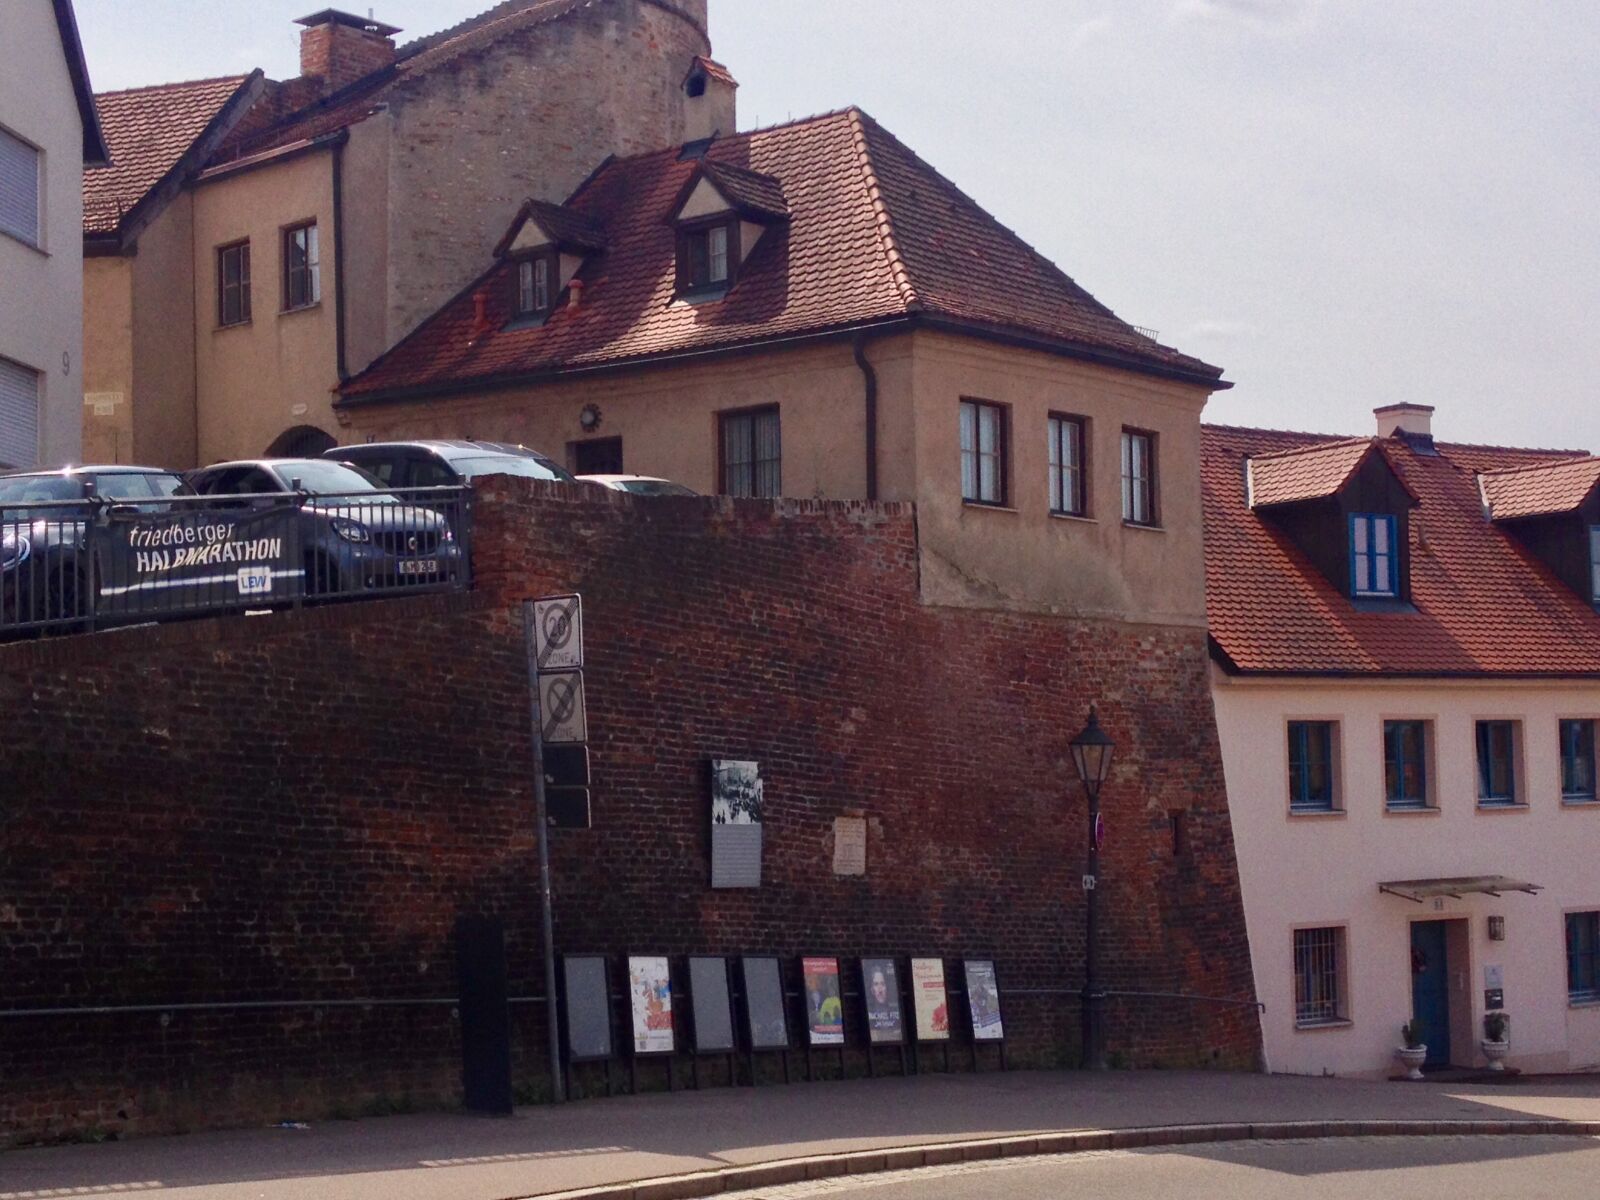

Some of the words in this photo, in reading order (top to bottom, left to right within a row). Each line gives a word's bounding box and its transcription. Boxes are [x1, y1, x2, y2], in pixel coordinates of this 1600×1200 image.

[63, 352, 70, 376] 9
[136, 538, 281, 572] HALBMARATHON
[241, 575, 267, 589] LEW
[550, 615, 566, 638] 20
[547, 652, 571, 665] ZONE
